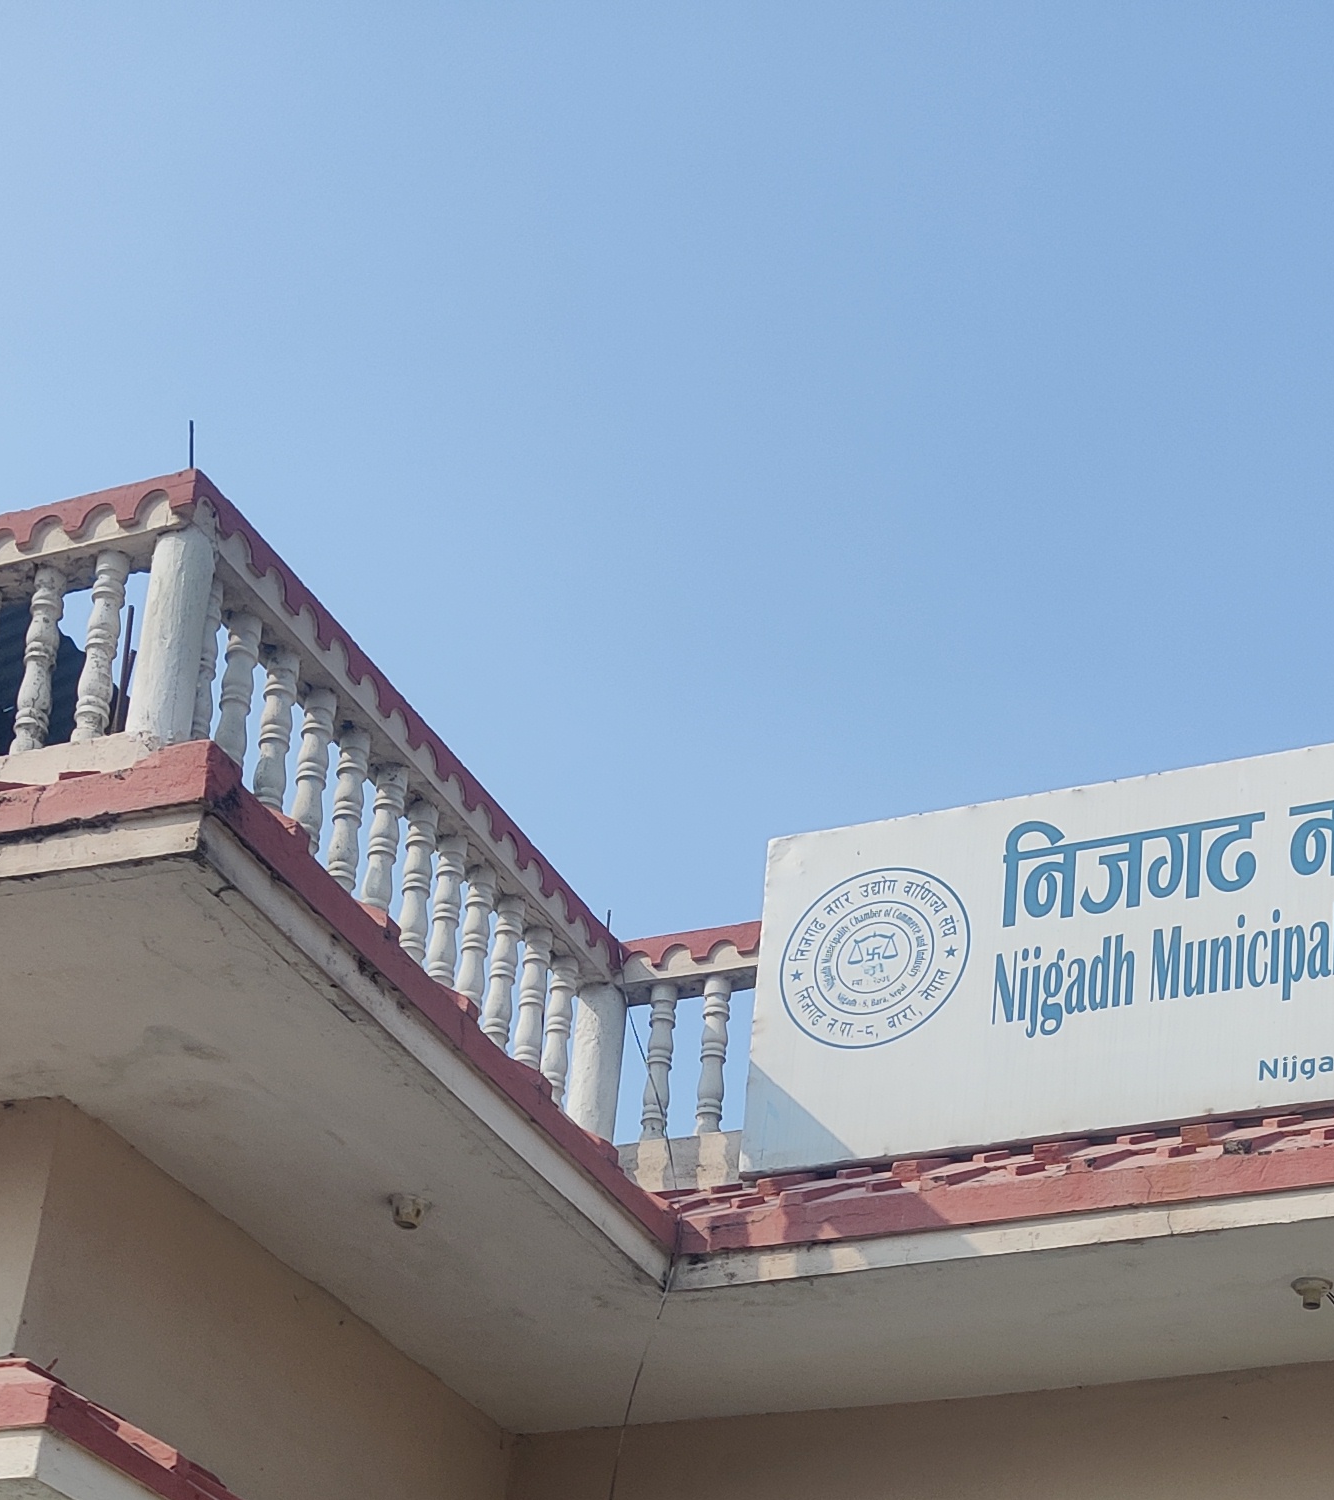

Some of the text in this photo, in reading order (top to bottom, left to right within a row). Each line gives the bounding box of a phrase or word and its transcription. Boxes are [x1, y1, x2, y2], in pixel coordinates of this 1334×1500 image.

[1003, 812, 1265, 927] निजगढ
[788, 876, 959, 961] निजगढ नगर उद्योग वाणिज्य संघ
[850, 908, 882, 927] Chamber
[795, 986, 827, 1026] निजगढ
[918, 968, 951, 1000] नेपाल
[992, 933, 1135, 1039] Nijgadh
